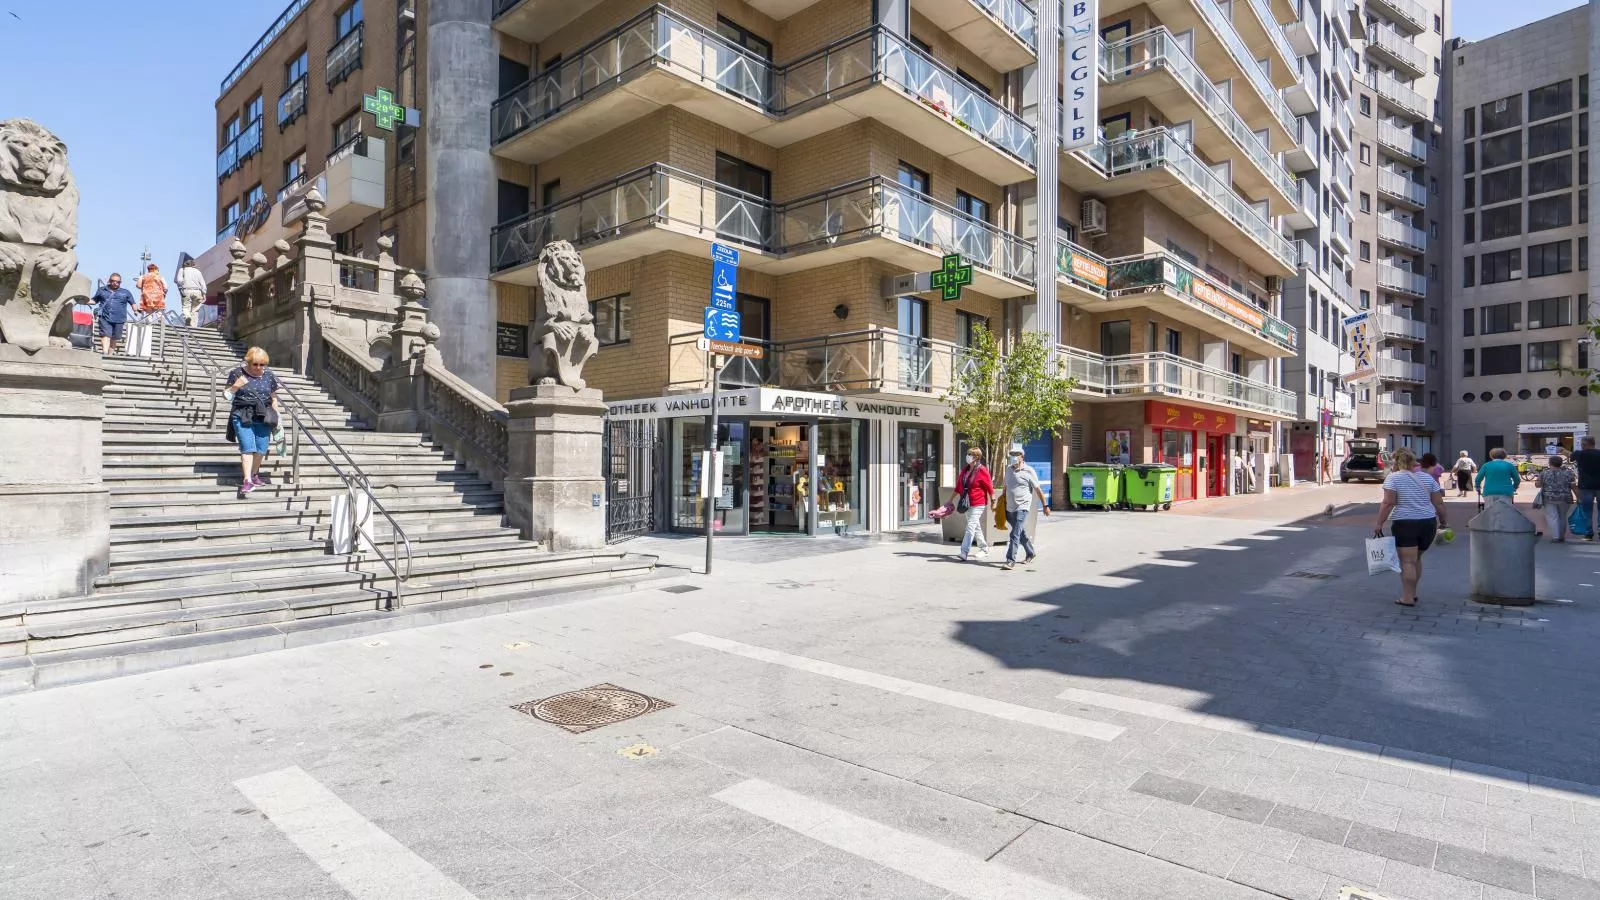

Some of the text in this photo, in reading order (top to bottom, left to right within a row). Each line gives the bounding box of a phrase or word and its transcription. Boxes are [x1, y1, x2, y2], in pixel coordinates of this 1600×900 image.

[1070, 45, 1088, 141] CGSLB
[937, 271, 967, 284] 11:47
[715, 298, 732, 309] 225m
[609, 395, 748, 416] OTHEEK VANHOTTE
[775, 395, 921, 417] APOTHEEK VANHOUTTE
